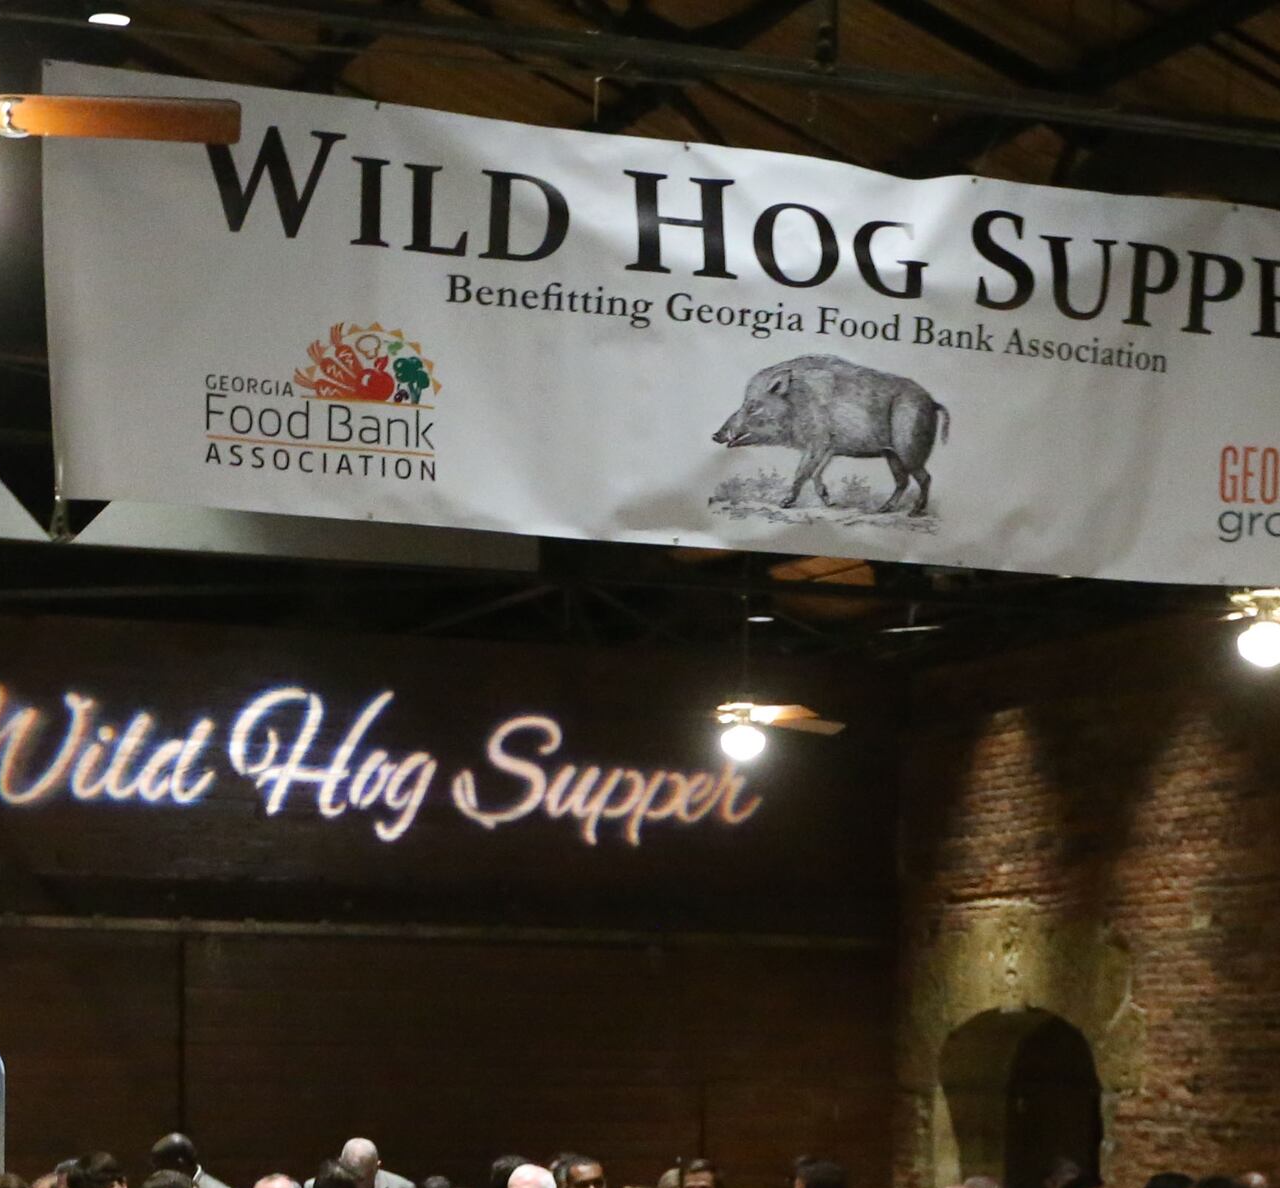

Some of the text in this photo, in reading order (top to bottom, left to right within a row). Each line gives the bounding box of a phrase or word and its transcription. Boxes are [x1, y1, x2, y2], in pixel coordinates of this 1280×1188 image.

[205, 125, 570, 262] WILD
[624, 170, 928, 301] HOG
[446, 273, 1169, 375] Benefitting Georgia Food Bank Association
[205, 373, 295, 399] GEORGIA
[205, 393, 436, 451] Food Bank
[205, 441, 437, 482] ASSOCIATION
[229, 685, 440, 842] Hog
[453, 714, 763, 846] Supper
